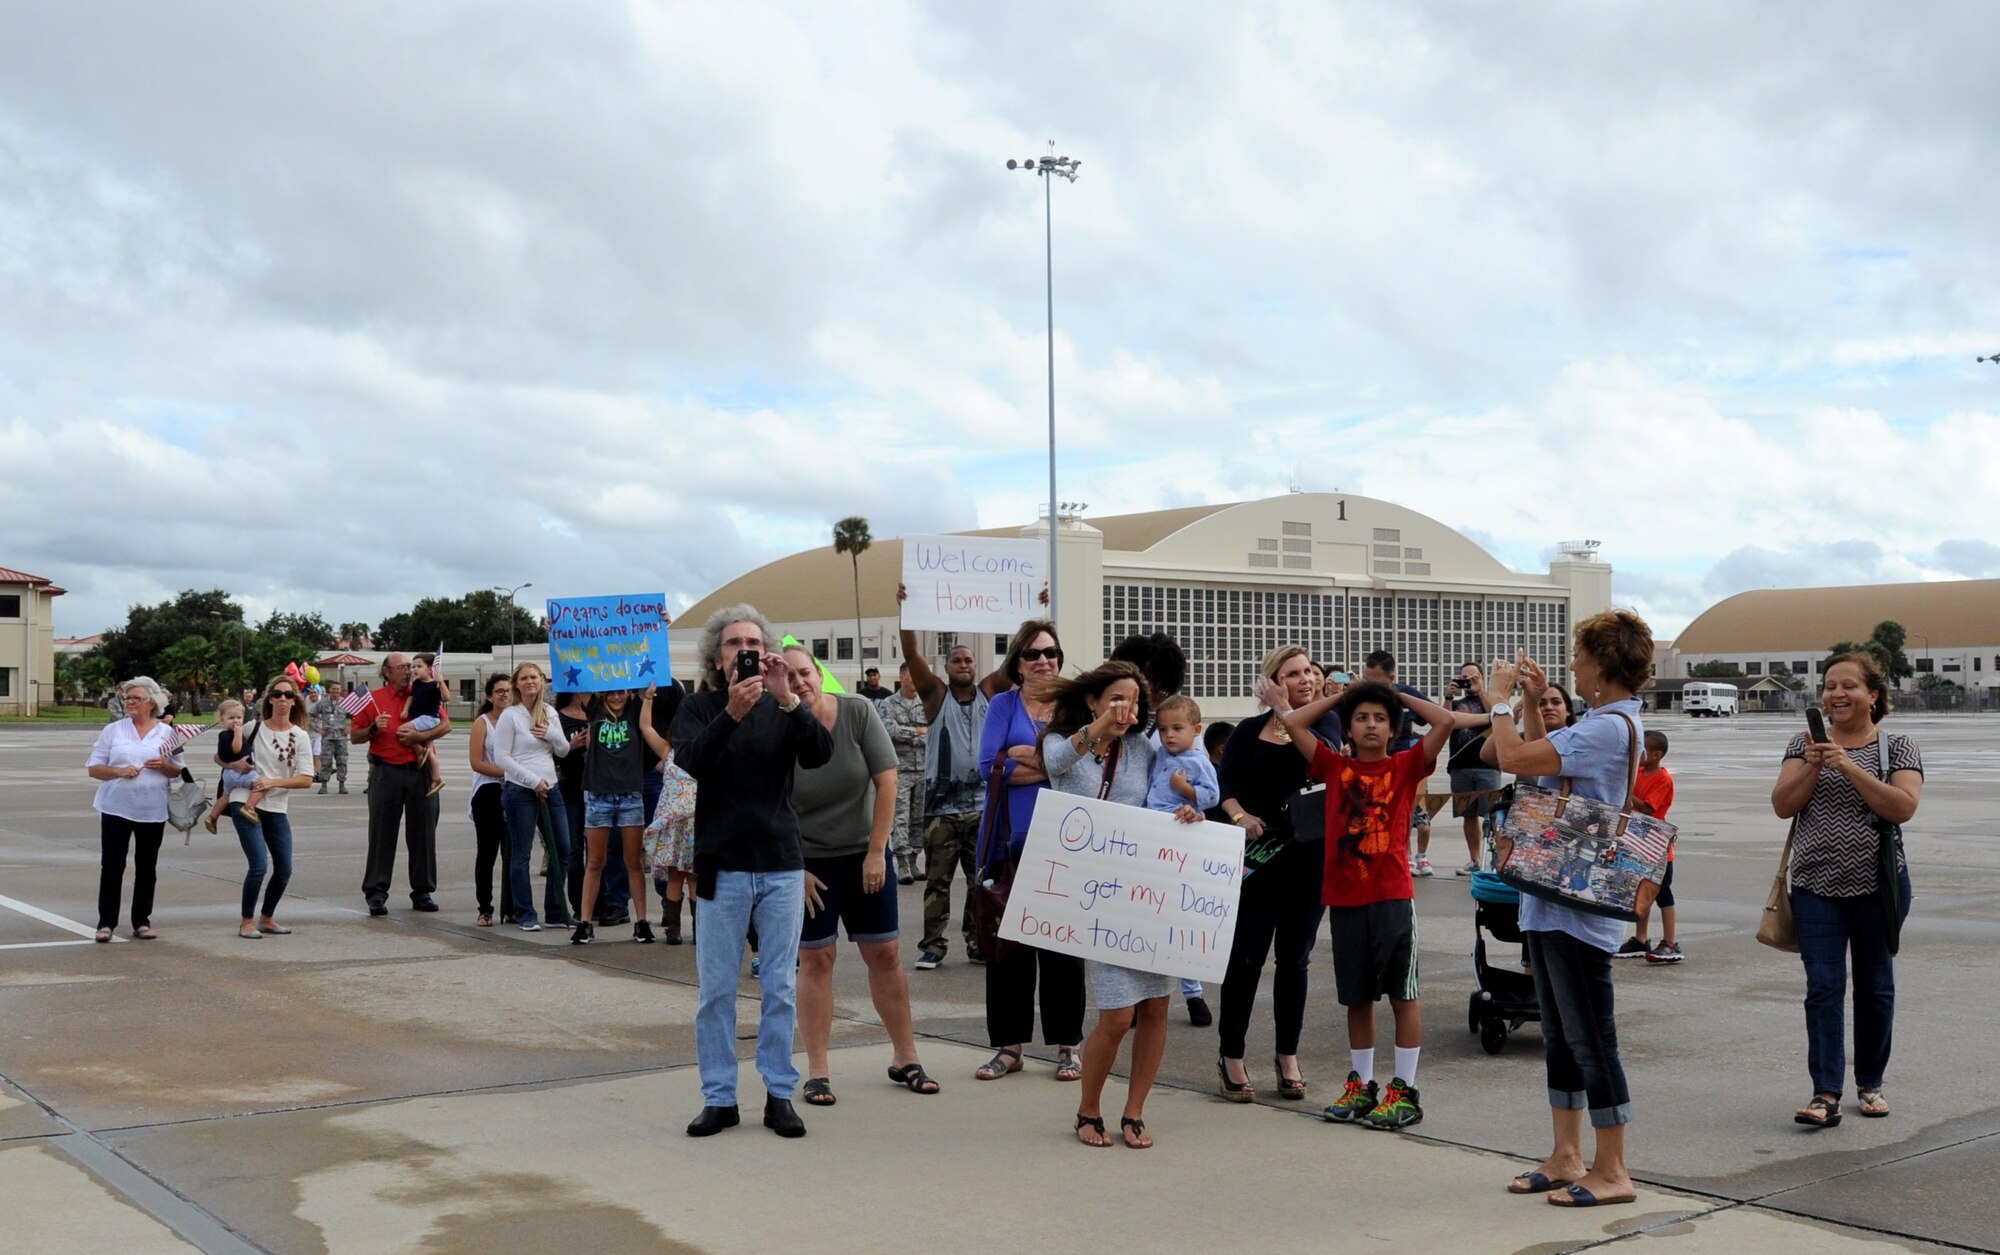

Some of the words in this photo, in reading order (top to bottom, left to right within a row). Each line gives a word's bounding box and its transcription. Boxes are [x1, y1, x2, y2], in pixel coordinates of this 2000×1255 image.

[1336, 500, 1348, 521] 1
[916, 543, 1035, 577] Welcome
[550, 601, 608, 624] Dreams
[552, 624, 577, 640] true!
[580, 623, 628, 639] Welcome
[631, 618, 662, 635] home!
[599, 729, 629, 743] GAME
[1059, 806, 1137, 857] Outta
[1158, 848, 1188, 873] my
[1034, 860, 1069, 898] I
[1080, 878, 1123, 911] get
[1131, 885, 1166, 914] my
[1181, 883, 1231, 928] Daddy
[1020, 907, 1082, 945] back
